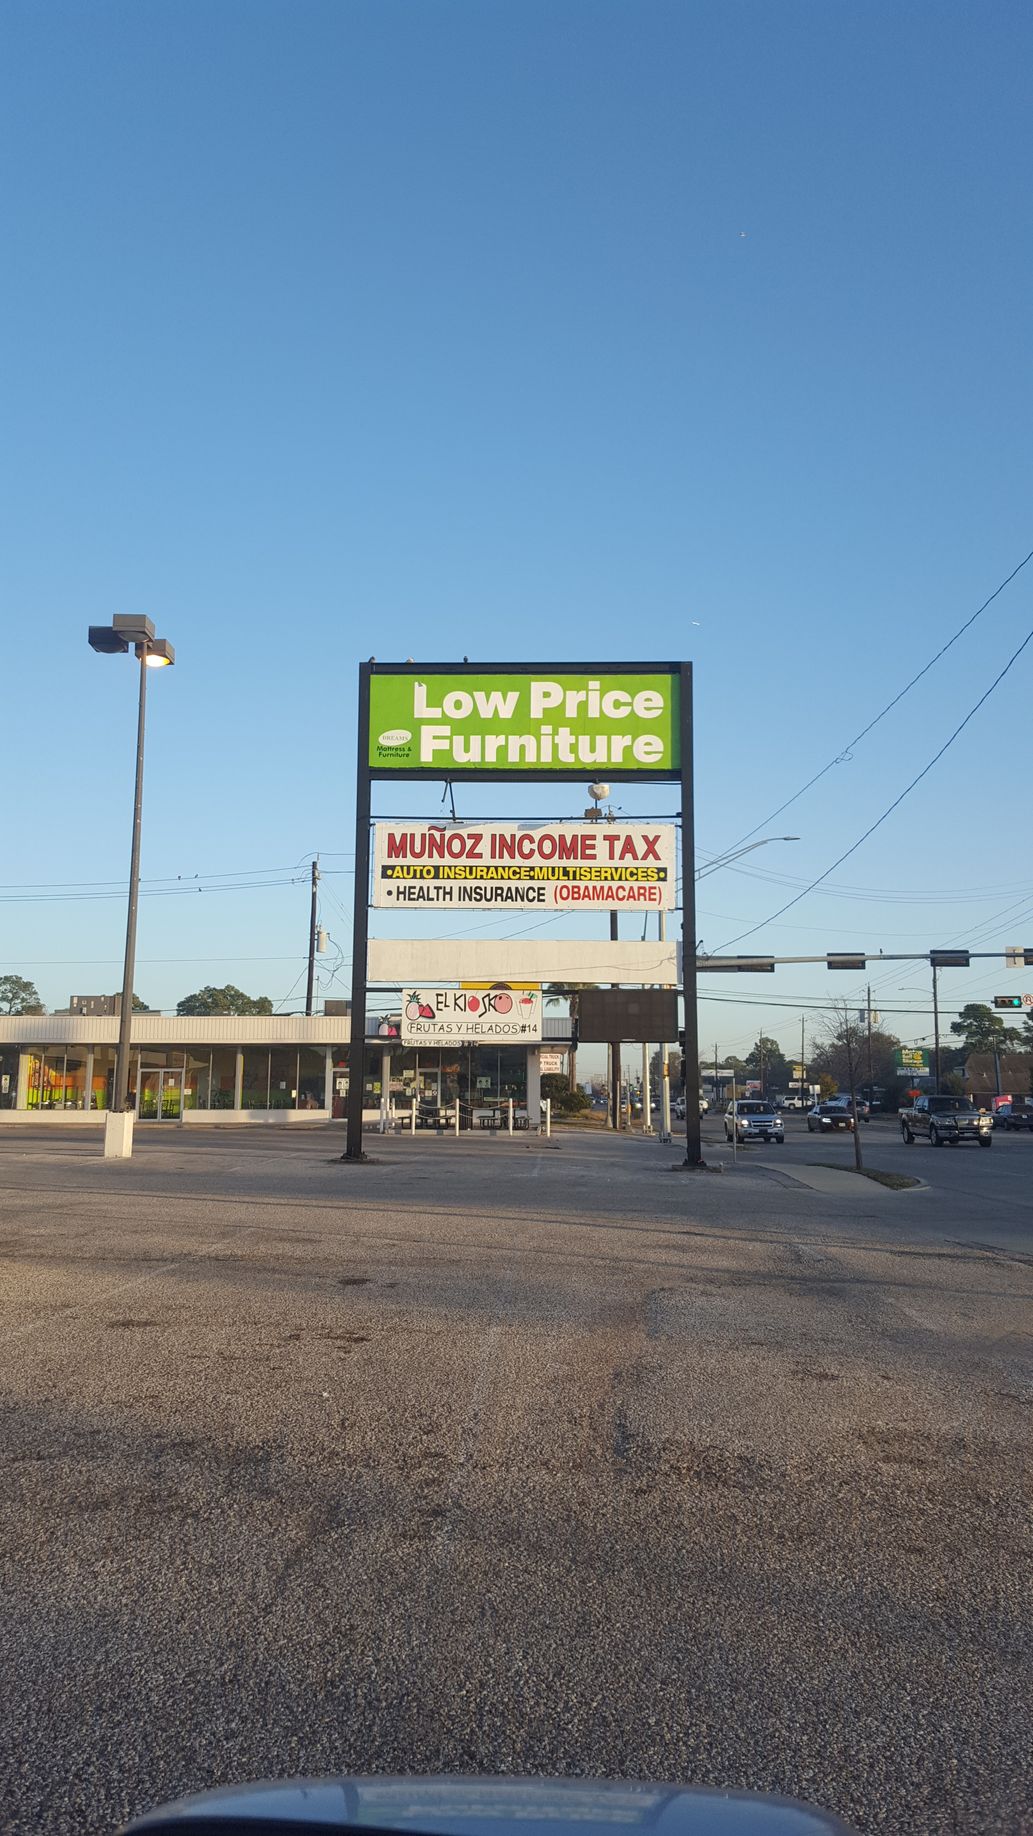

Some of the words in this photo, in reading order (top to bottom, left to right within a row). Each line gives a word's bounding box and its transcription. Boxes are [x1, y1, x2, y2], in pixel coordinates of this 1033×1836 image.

[414, 681, 520, 719] Low
[530, 681, 664, 719] Price
[420, 725, 664, 763] Furniture
[387, 825, 483, 859] MUÑOZ
[490, 833, 597, 861] INCOME
[603, 834, 662, 861] TAX
[396, 885, 453, 901] HEALTH
[458, 886, 546, 902] INSURANCE
[554, 884, 662, 905] (OBAMACARE)
[435, 992, 450, 1011] EL
[409, 1023, 453, 1033] FRUTAS
[457, 1024, 463, 1033] Y
[466, 1024, 518, 1034] HELADOS
[520, 1024, 537, 1033] #14
